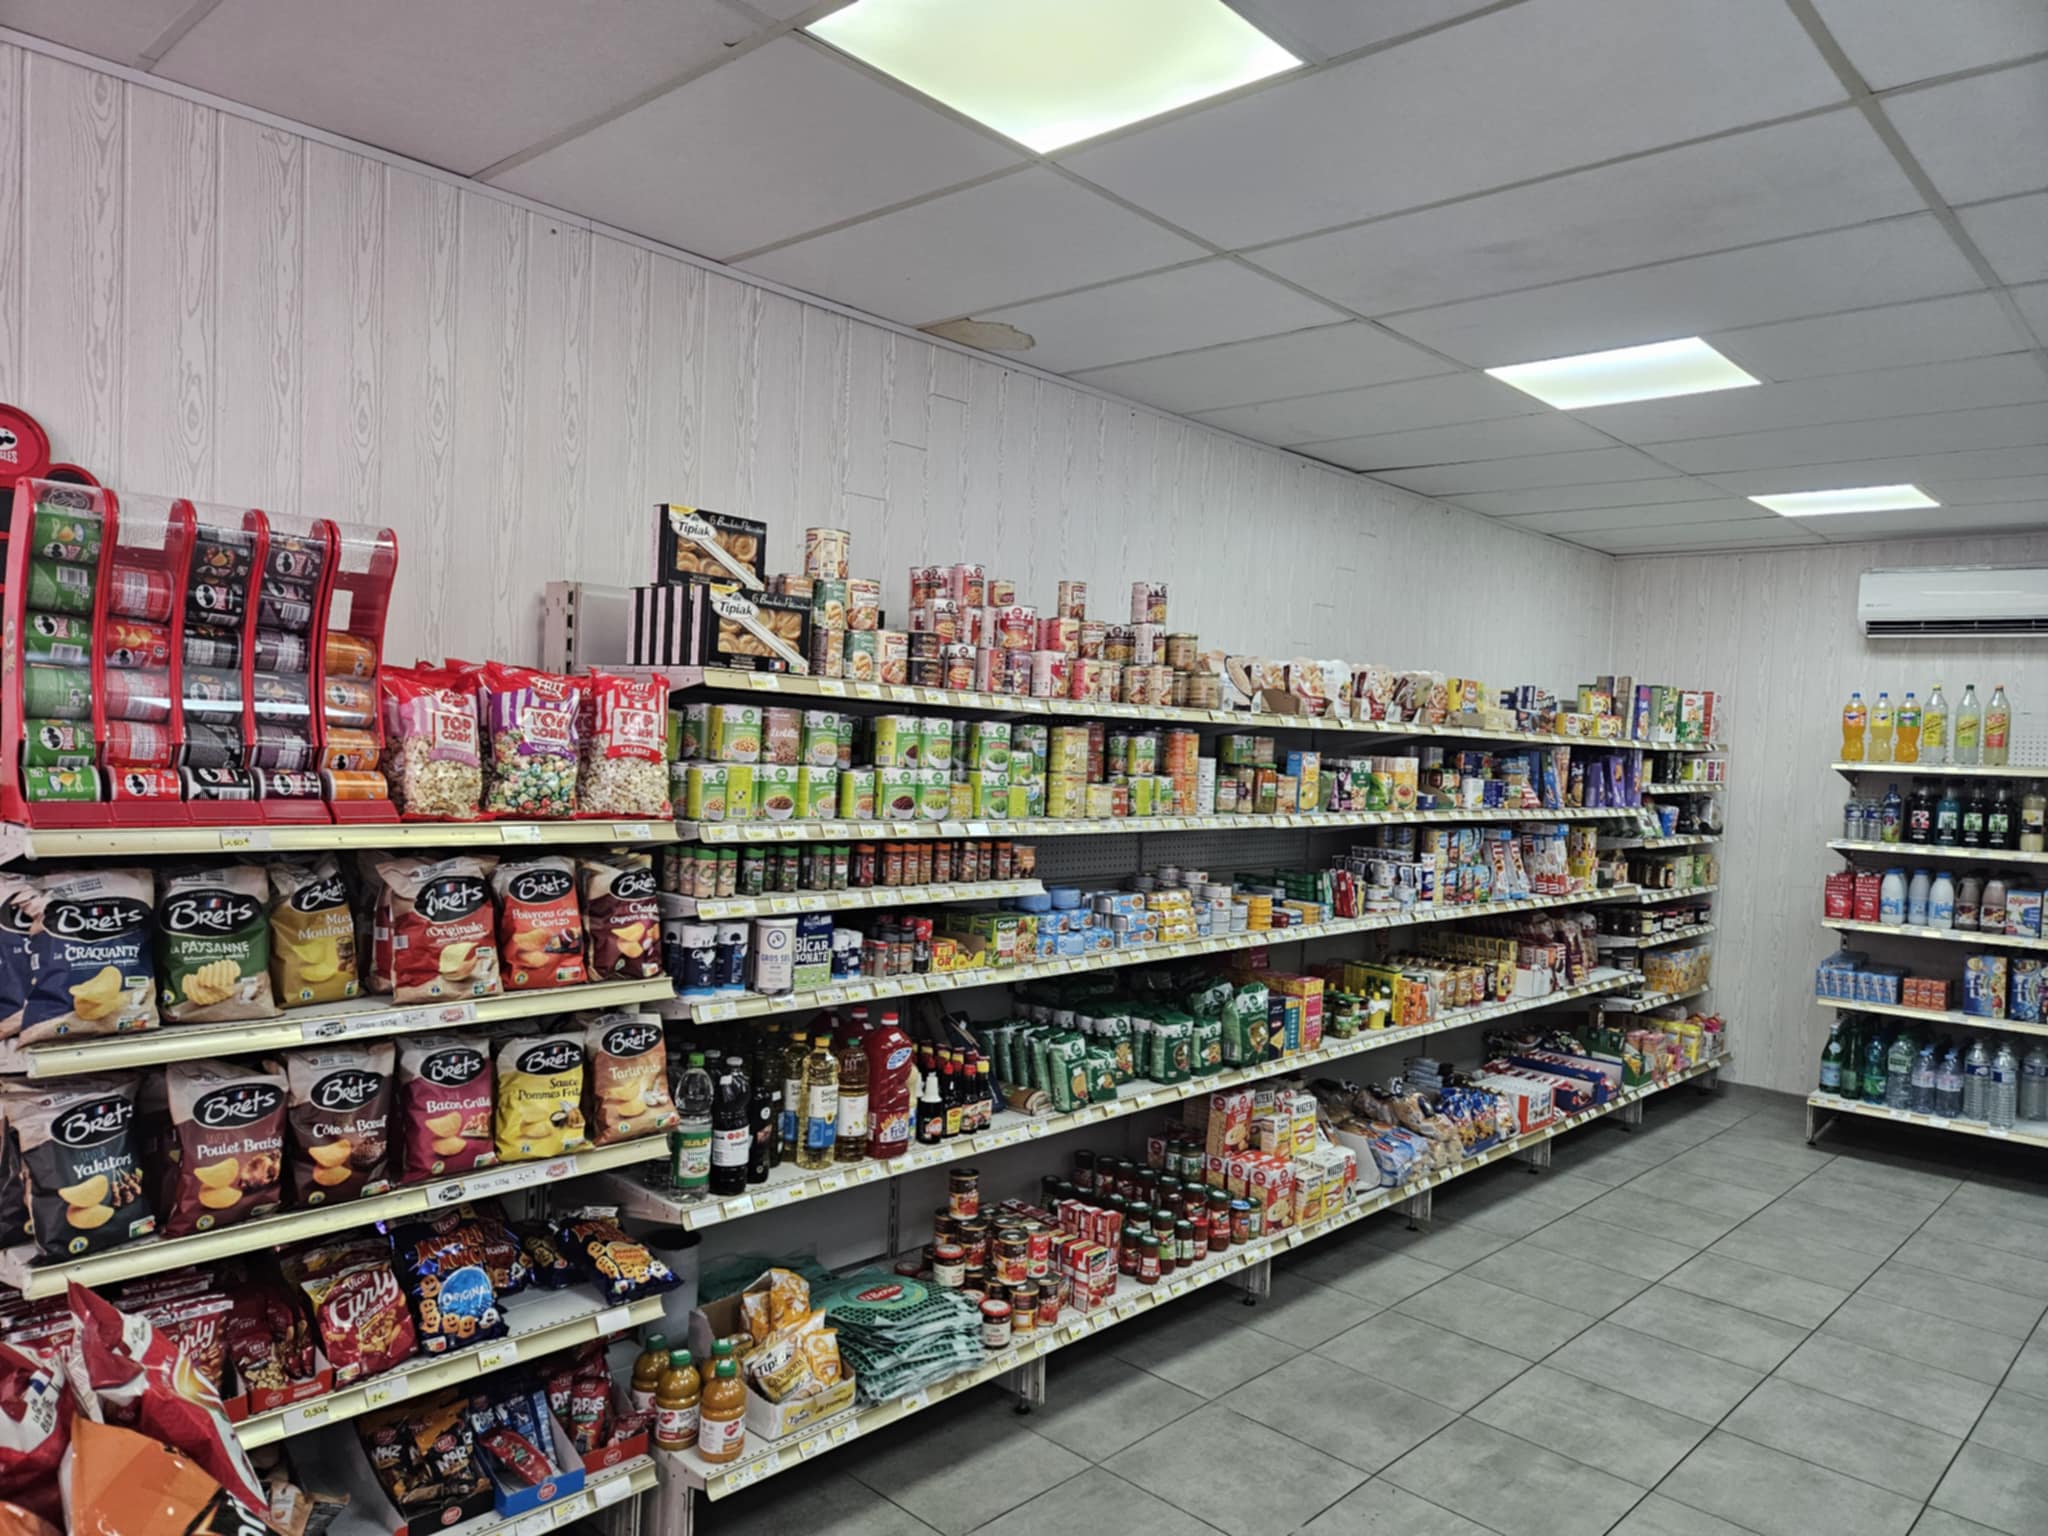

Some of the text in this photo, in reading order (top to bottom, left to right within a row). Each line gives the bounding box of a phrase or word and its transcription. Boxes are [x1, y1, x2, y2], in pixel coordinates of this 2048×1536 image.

[678, 521, 711, 538] Tipiak
[720, 601, 752, 617] Tipiak
[441, 715, 471, 730] TOP
[442, 730, 471, 743] CORN
[531, 728, 567, 741] CORN
[518, 875, 570, 900] Brets
[56, 906, 143, 934] Brets
[169, 900, 253, 931] Brets
[532, 917, 569, 928] Chorizo
[426, 921, 484, 938] Originale
[181, 941, 249, 955] PAYSANNE
[760, 953, 778, 962] GROS
[609, 1029, 657, 1055] Brets
[429, 1056, 481, 1081] Brets
[525, 1047, 580, 1073] Brets
[322, 1078, 379, 1108] Brets
[518, 1088, 561, 1102] Pommes
[204, 1091, 276, 1124] Brets
[426, 1099, 462, 1114] Bacon
[197, 1143, 241, 1160] Poulet
[243, 1136, 283, 1152] Braisé
[73, 1153, 132, 1179] Yakitori
[345, 1275, 369, 1291] Vico
[329, 1269, 399, 1333] Curly
